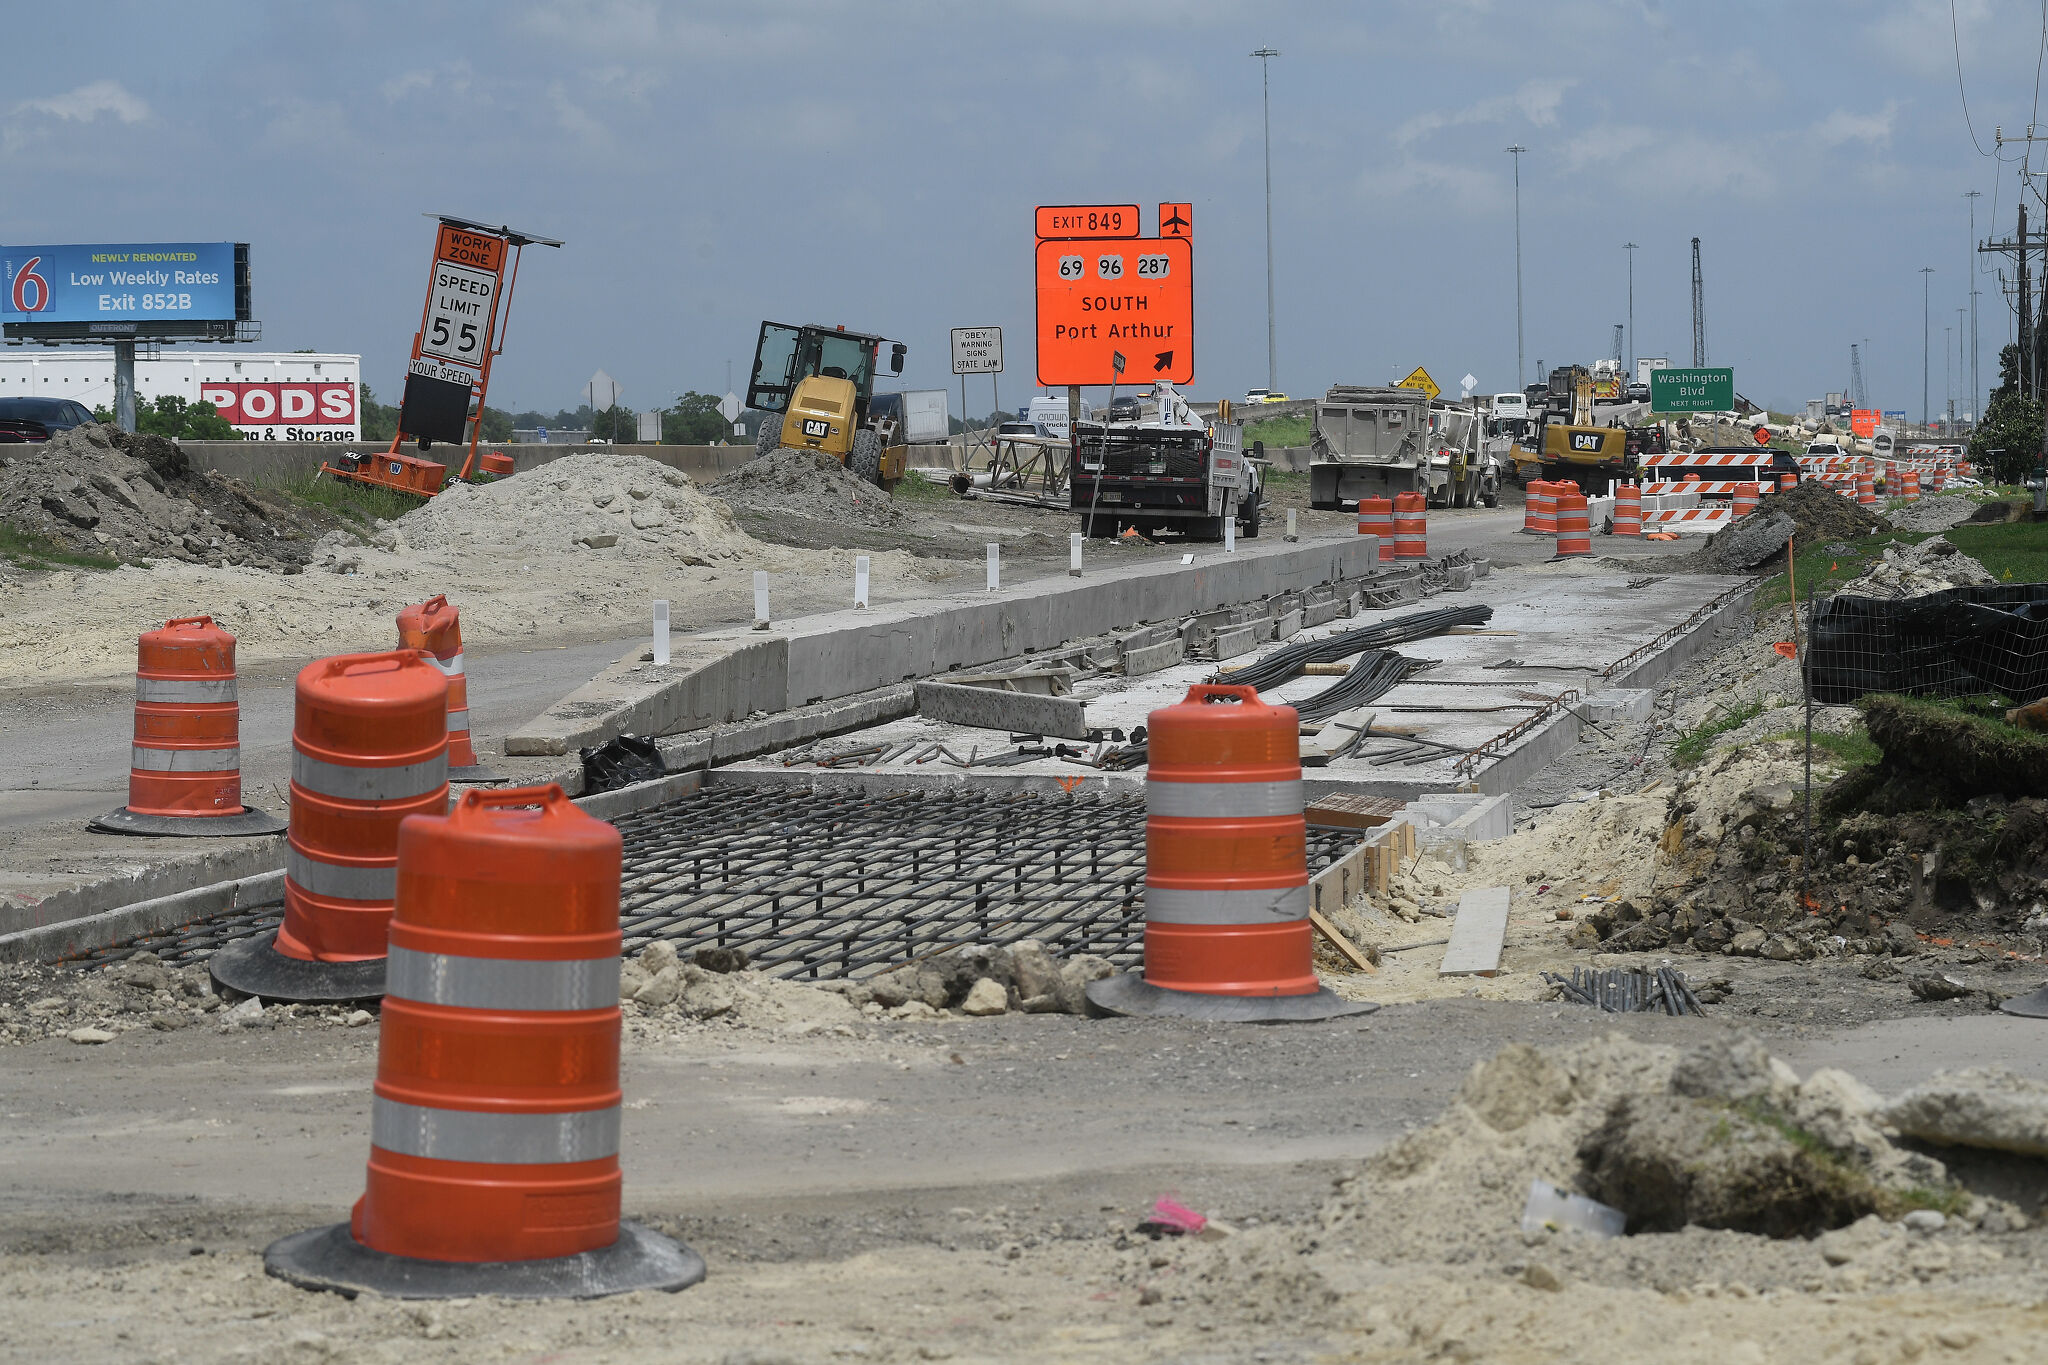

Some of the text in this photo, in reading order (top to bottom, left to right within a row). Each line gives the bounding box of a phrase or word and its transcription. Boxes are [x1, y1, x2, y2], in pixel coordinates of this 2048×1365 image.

[1053, 212, 1122, 231] EXIT 849
[451, 232, 492, 252] WORK
[92, 252, 197, 263] NEWLY RENOVATED
[449, 246, 490, 265] ZONE
[1060, 260, 1083, 276] 69
[1099, 259, 1121, 275] 96
[1138, 258, 1169, 274] 287
[12, 256, 49, 312] 6
[70, 269, 219, 287] Low Weekly Rates
[439, 274, 490, 297] SPEED
[99, 293, 192, 311] Exit 852B
[440, 295, 480, 317] LIMIT
[1081, 296, 1148, 312] SOUTH
[964, 331, 987, 339] OBEY
[1055, 322, 1174, 339] Port Arthur
[960, 341, 992, 349] WARNING
[966, 349, 987, 357] SIGNS
[957, 359, 998, 368] STATE LAW
[411, 360, 471, 386] YOUR SPEED
[1411, 375, 1428, 383] BRIDGE
[1657, 373, 1727, 385] Washington
[1680, 386, 1705, 396] Blvd
[202, 389, 352, 419] PODS
[286, 427, 355, 441] Storage
[805, 420, 828, 436] CAT
[1575, 434, 1598, 450] CAT
